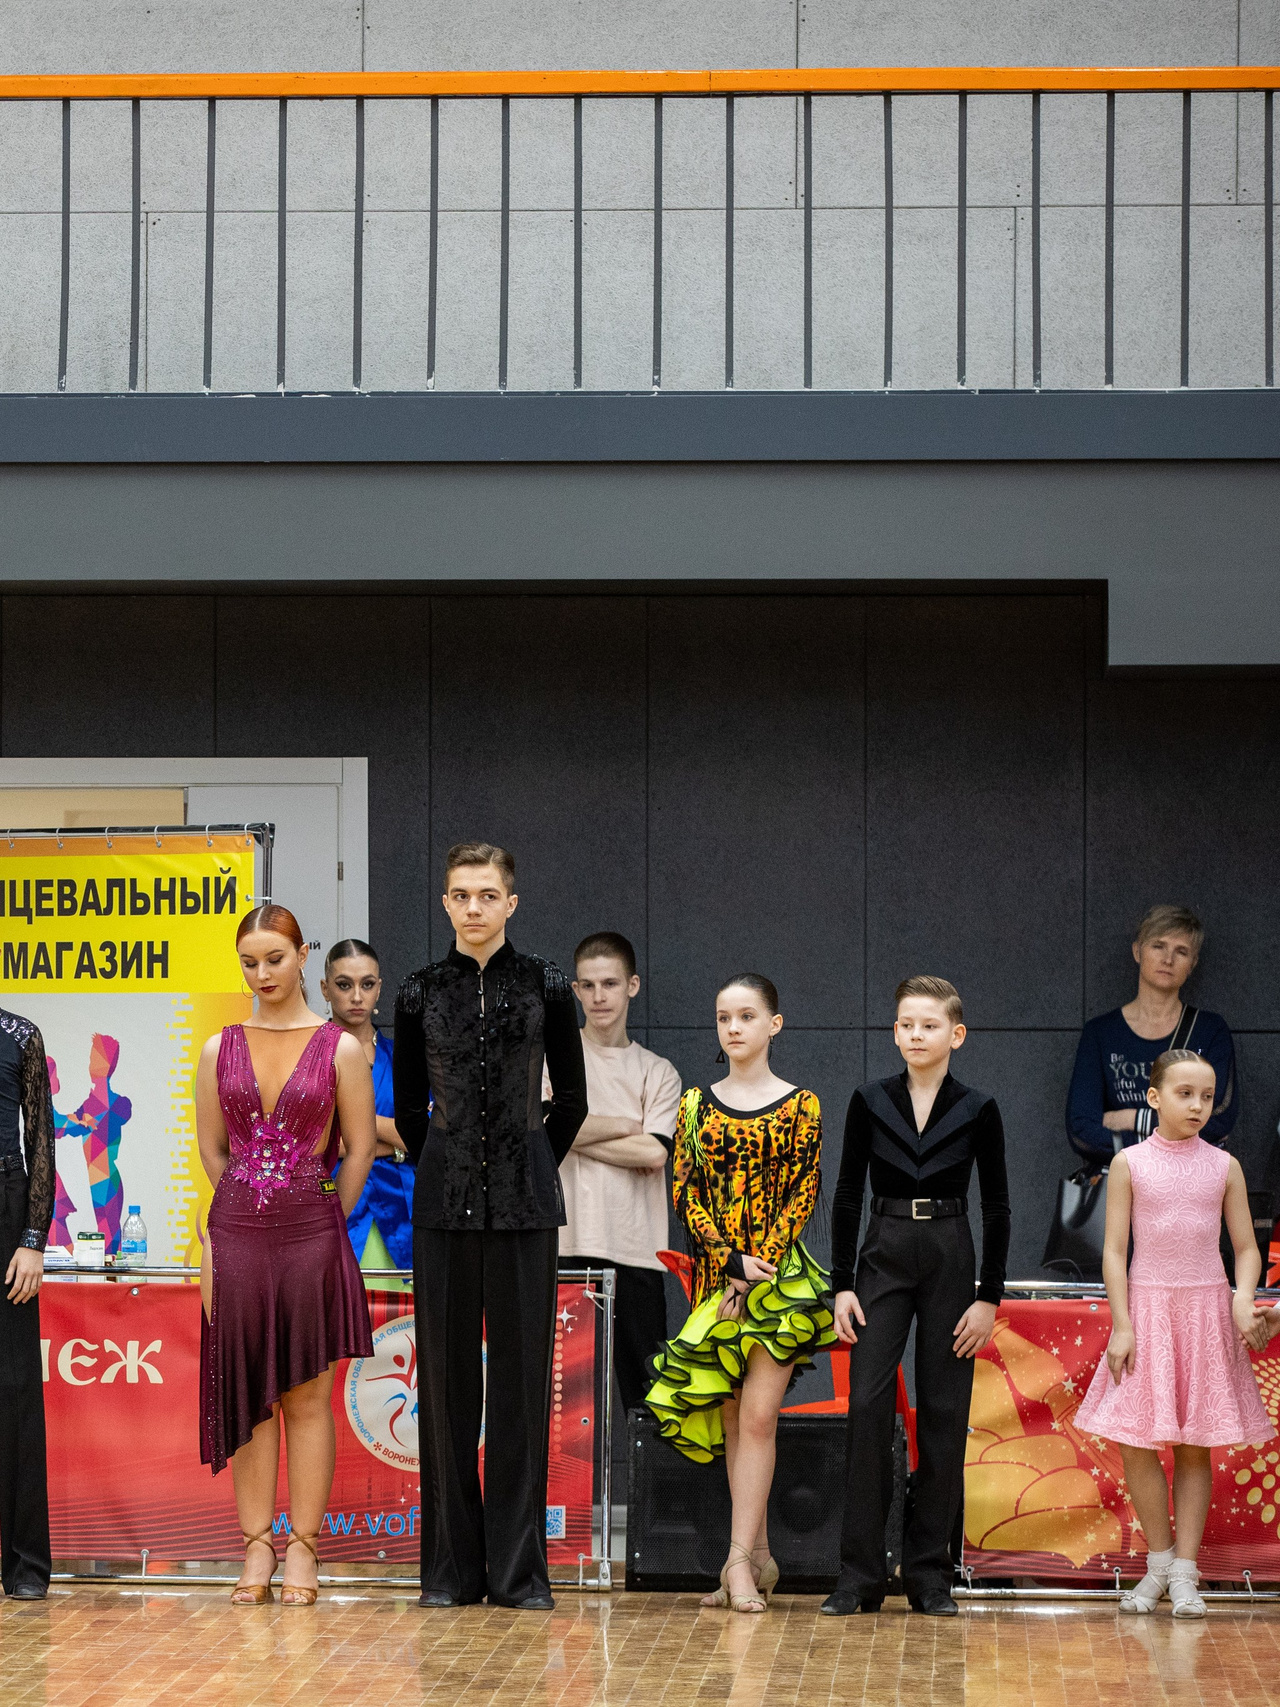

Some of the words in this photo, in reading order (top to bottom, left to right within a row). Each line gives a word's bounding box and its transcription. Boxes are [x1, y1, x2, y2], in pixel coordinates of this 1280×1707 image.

[3, 941, 170, 980] МАГАЗИН
[1110, 1053, 1125, 1064] Be
[350, 1380, 375, 1444] ВОРОНЕЖСКАЯ
